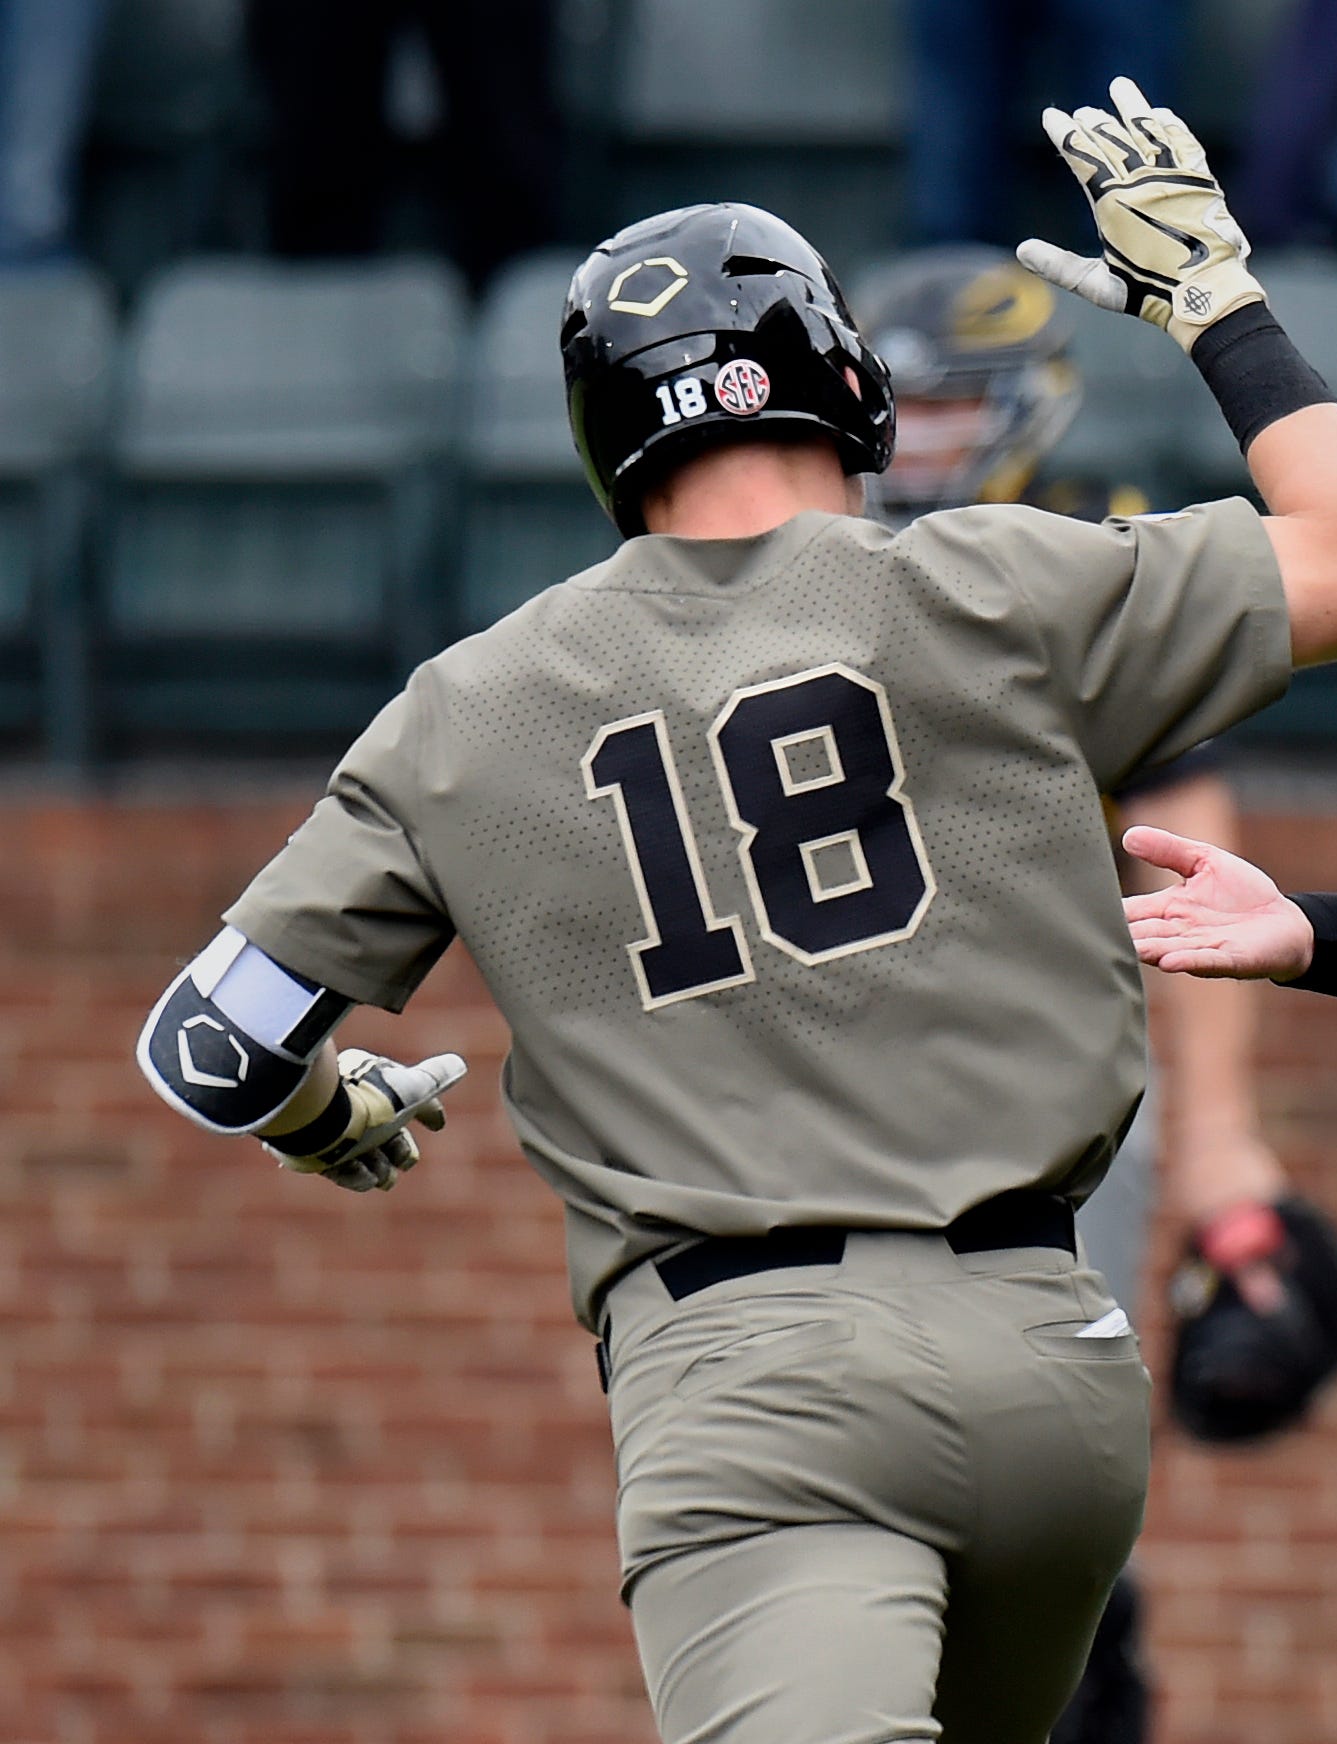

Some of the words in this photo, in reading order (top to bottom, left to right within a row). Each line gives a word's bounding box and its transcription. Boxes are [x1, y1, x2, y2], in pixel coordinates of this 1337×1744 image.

[656, 377, 708, 426] 18
[720, 364, 768, 410] SEC
[580, 661, 938, 1011] 18
